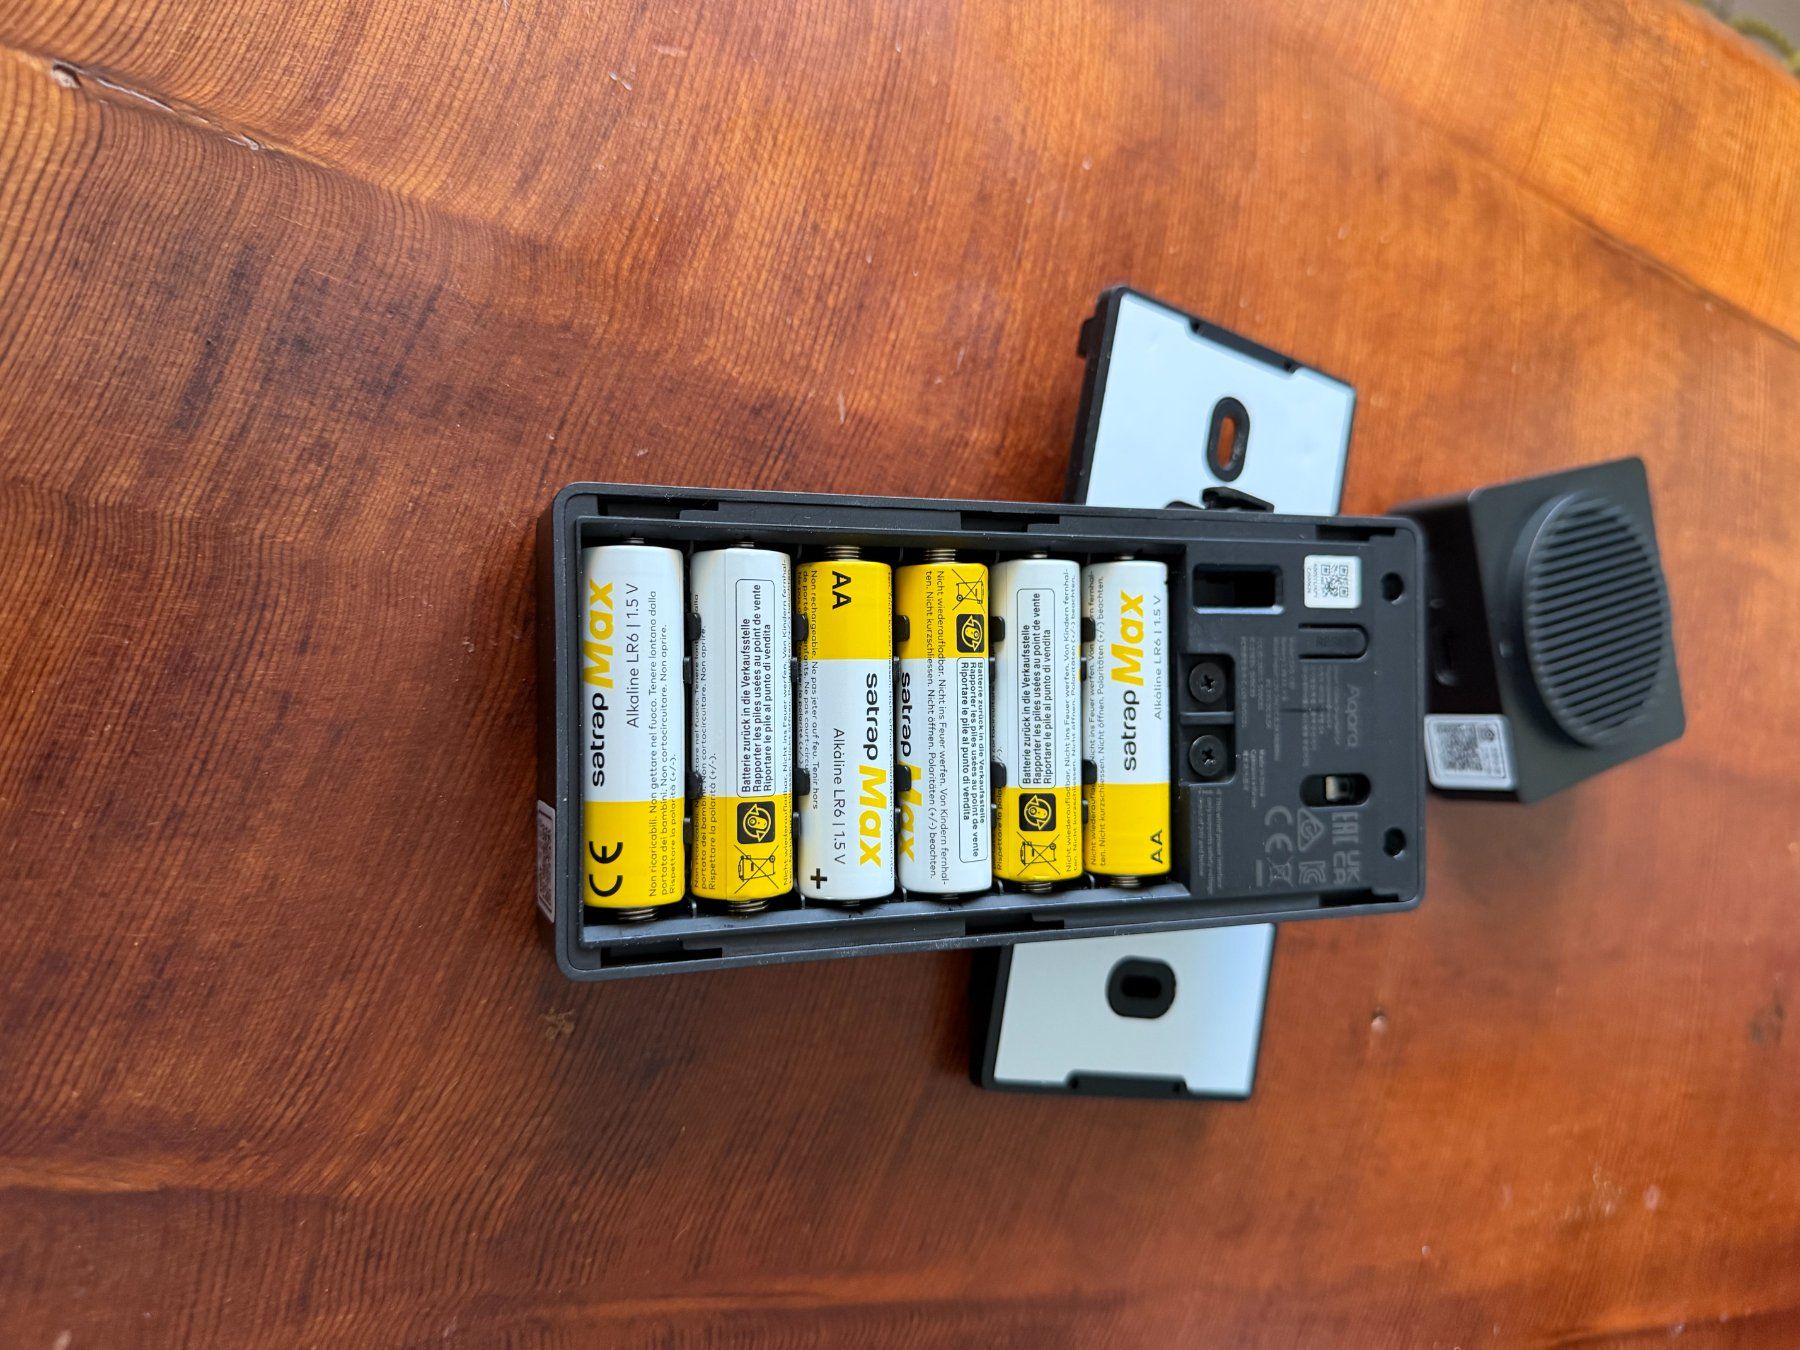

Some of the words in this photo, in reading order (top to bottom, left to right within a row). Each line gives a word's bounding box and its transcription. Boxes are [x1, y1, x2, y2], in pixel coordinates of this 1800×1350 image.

[626, 584, 639, 594] V
[832, 570, 851, 610] AA
[925, 571, 934, 588] ten.
[937, 571, 945, 595] Nicht
[626, 599, 639, 618] 1.5
[648, 591, 657, 616] dalla
[752, 585, 761, 610] vente
[926, 592, 934, 616] Nicht
[1032, 594, 1040, 617] vente
[1153, 596, 1161, 605] V
[753, 614, 761, 625] de
[809, 593, 818, 659] rechargeable.
[1032, 620, 1040, 630] de
[1153, 609, 1161, 625] 1.5
[582, 579, 614, 688] Max
[648, 619, 657, 658] lontano
[660, 625, 669, 657] aprire.
[700, 626, 708, 658] aprire.
[753, 628, 763, 652] point
[763, 625, 771, 659] vendita
[937, 598, 946, 676] wiederaufladbar.
[1032, 633, 1043, 655] point
[1097, 622, 1106, 642] (+/-)
[1110, 589, 1144, 687] Max
[626, 634, 639, 662] LR6
[741, 619, 750, 687] Verkaufsstelle
[926, 619, 935, 687] kurzschliessen.
[1022, 625, 1030, 688] Verkaufsstelle
[1043, 630, 1051, 662] vendita
[1153, 639, 1161, 664] LR6
[755, 656, 761, 666] au
[763, 663, 771, 671] di
[811, 662, 819, 674] Ne
[1034, 659, 1041, 669] au
[1043, 665, 1051, 673] di
[648, 662, 657, 695] Tenere
[753, 670, 761, 698] usées
[763, 674, 773, 701] punto
[960, 662, 969, 704] Riportare
[969, 662, 978, 707] Rapporter
[1032, 671, 1041, 697] usées
[1043, 675, 1053, 700] punto
[626, 668, 639, 727] Alkaline
[741, 690, 750, 704] die
[927, 690, 935, 714] Nicht
[938, 680, 947, 704] Nicht
[1022, 691, 1031, 704] die
[648, 699, 657, 729] fuoco.
[741, 708, 750, 716] in
[753, 701, 763, 723] piles
[763, 704, 771, 712] al
[810, 698, 819, 718] jeter
[864, 673, 880, 761] satrap
[901, 673, 912, 757] satrap
[939, 707, 947, 719] ins
[1033, 700, 1043, 721] piles
[1344, 683, 1361, 746] Aqara
[753, 727, 761, 740] les
[763, 715, 773, 732] pile
[927, 717, 936, 749] öffnen.
[960, 718, 969, 734] pile
[1022, 717, 1031, 746] zurück
[1033, 724, 1041, 736] les
[1043, 714, 1053, 729] pile
[1121, 690, 1140, 771] satrap
[590, 693, 609, 786] satrap
[648, 733, 657, 747] nel
[741, 719, 750, 751] zurück
[763, 735, 771, 743] le
[939, 723, 947, 748] Feuer
[970, 726, 978, 747] piles
[648, 751, 659, 789] gettare
[669, 754, 677, 781] (+/-).
[709, 754, 718, 779] (+/-).
[742, 754, 750, 792] Batterie
[753, 744, 763, 792] Rapporter
[763, 746, 773, 791] Riportare
[939, 751, 948, 786] werfen.
[961, 747, 970, 773] punto
[1022, 749, 1031, 784] Batterie
[1033, 740, 1043, 784] Rapporter
[1043, 742, 1053, 784] Riportare
[928, 753, 936, 804] Polaritäten
[963, 776, 970, 784] di
[972, 780, 977, 790] au
[648, 793, 657, 813] Non
[669, 785, 677, 824] polarità
[709, 783, 718, 822] polarità
[834, 790, 846, 817] LR6
[940, 789, 948, 806] Von
[858, 765, 888, 868] Max
[927, 808, 937, 830] (+/-)
[940, 809, 948, 845] Kindern
[972, 819, 979, 829] de
[669, 828, 676, 837] la
[709, 826, 716, 834] la
[834, 832, 846, 849] 1.5
[648, 817, 657, 872] ricaricabili.
[929, 833, 937, 878] beachten.
[1150, 829, 1163, 864] AA
[669, 840, 677, 893] Rispettare
[700, 850, 708, 889] portata
[709, 838, 718, 889] Rispettare
[834, 855, 846, 864] V
[941, 848, 949, 884] fernhal-
[648, 876, 657, 896] Non
[660, 855, 669, 895] portata
